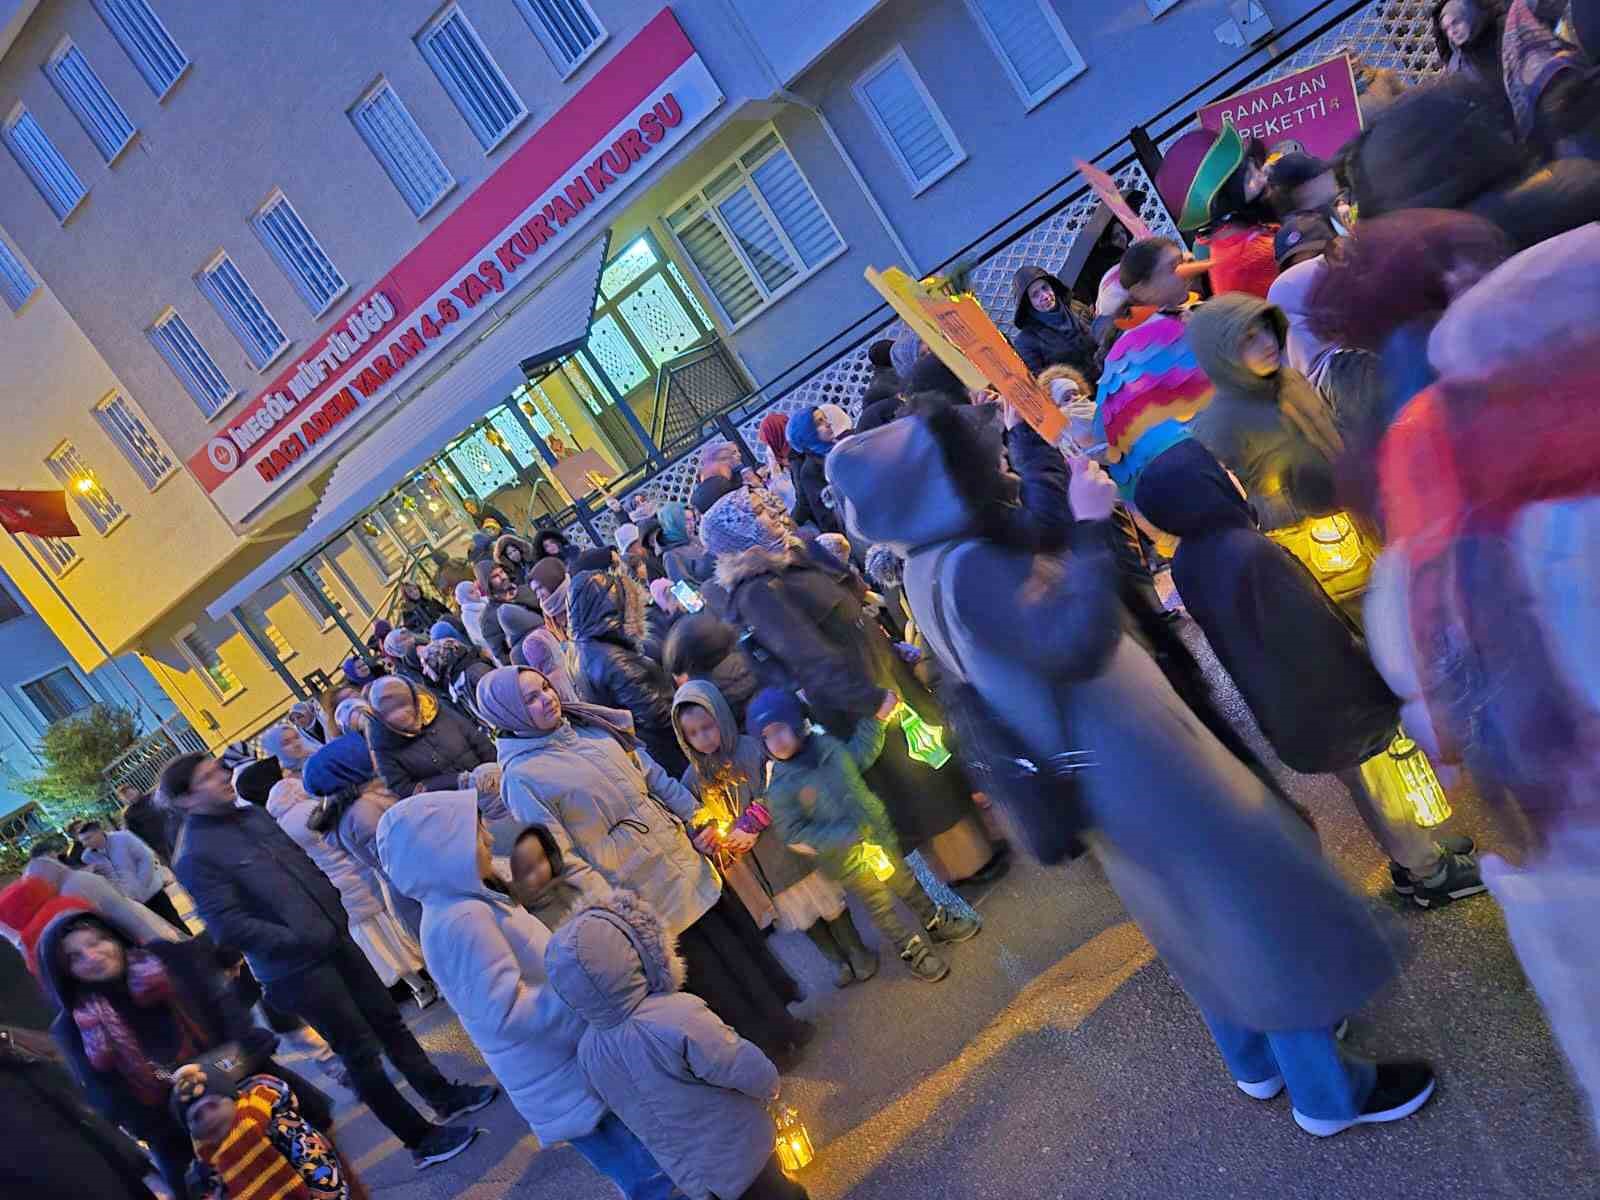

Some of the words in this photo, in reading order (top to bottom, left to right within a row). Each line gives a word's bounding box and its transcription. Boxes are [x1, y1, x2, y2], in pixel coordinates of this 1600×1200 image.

[1221, 74, 1327, 123] RAMAZAN
[255, 432, 305, 482] HACI
[300, 386, 360, 446] ADEM
[349, 327, 427, 399] YARAN
[421, 298, 459, 339] 4-6
[449, 260, 505, 309] YAŞ
[495, 175, 595, 273] KUR'AN
[584, 92, 683, 194] KURSU
[228, 391, 298, 452] İNEGÖL
[287, 291, 395, 401] MÜFTÜLÜĞÜ
